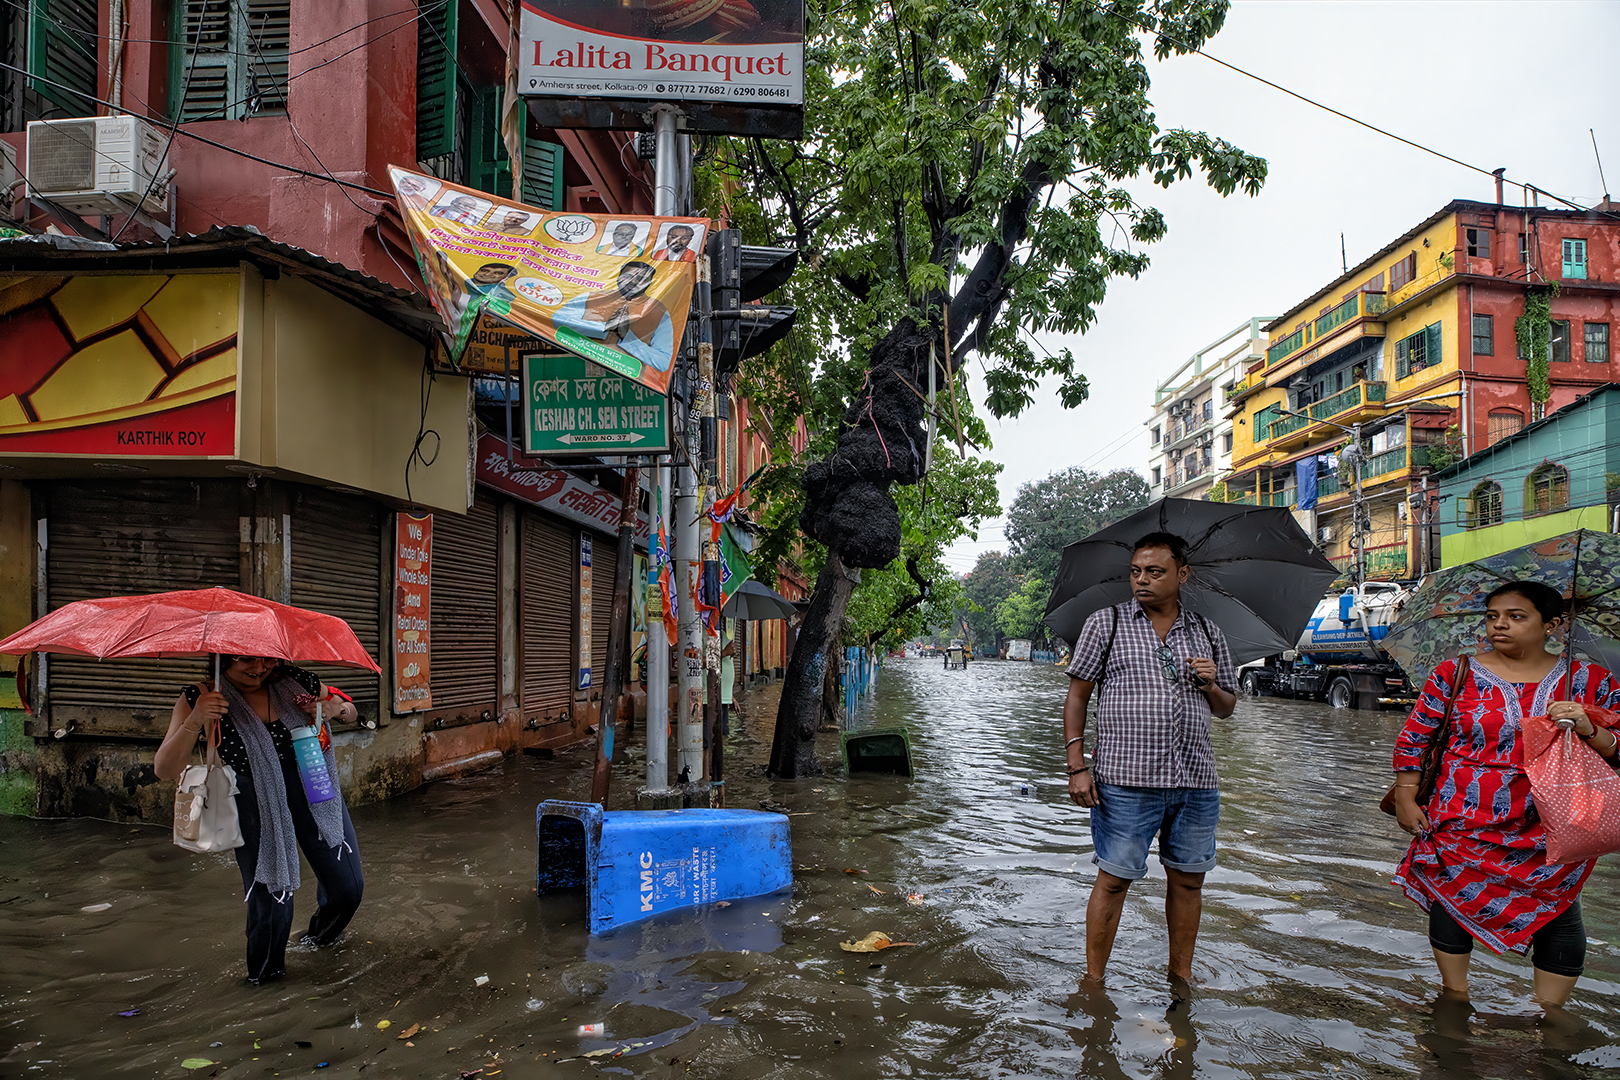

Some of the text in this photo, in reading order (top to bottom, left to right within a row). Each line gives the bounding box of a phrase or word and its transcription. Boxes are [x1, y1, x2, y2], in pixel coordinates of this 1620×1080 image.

[532, 40, 791, 82] Lalita Banquet
[539, 80, 574, 90] Amherst
[605, 83, 648, 92] Kolkata-09
[668, 84, 696, 94] 87772
[698, 86, 726, 94] 77682
[734, 88, 756, 96] 6290
[758, 88, 790, 97] 806481
[518, 284, 554, 304] BJYM
[533, 376, 568, 402] কেশব
[574, 379, 597, 400] চন্দ্র
[600, 378, 624, 400] সেন
[534, 406, 660, 432] KESHAB CH. SEN STREET
[118, 430, 206, 446] KARTHIK ROY
[408, 524, 422, 540] We
[400, 544, 428, 563] Under Take
[399, 567, 428, 586] Whole Sale
[408, 592, 421, 608] And
[398, 615, 427, 631] Retail Orders
[1336, 631, 1366, 639] DEPRTMEN
[398, 639, 426, 654] For All Sorts
[408, 662, 418, 677] Of
[692, 846, 700, 881] WASTE
[640, 851, 653, 912] KMC
